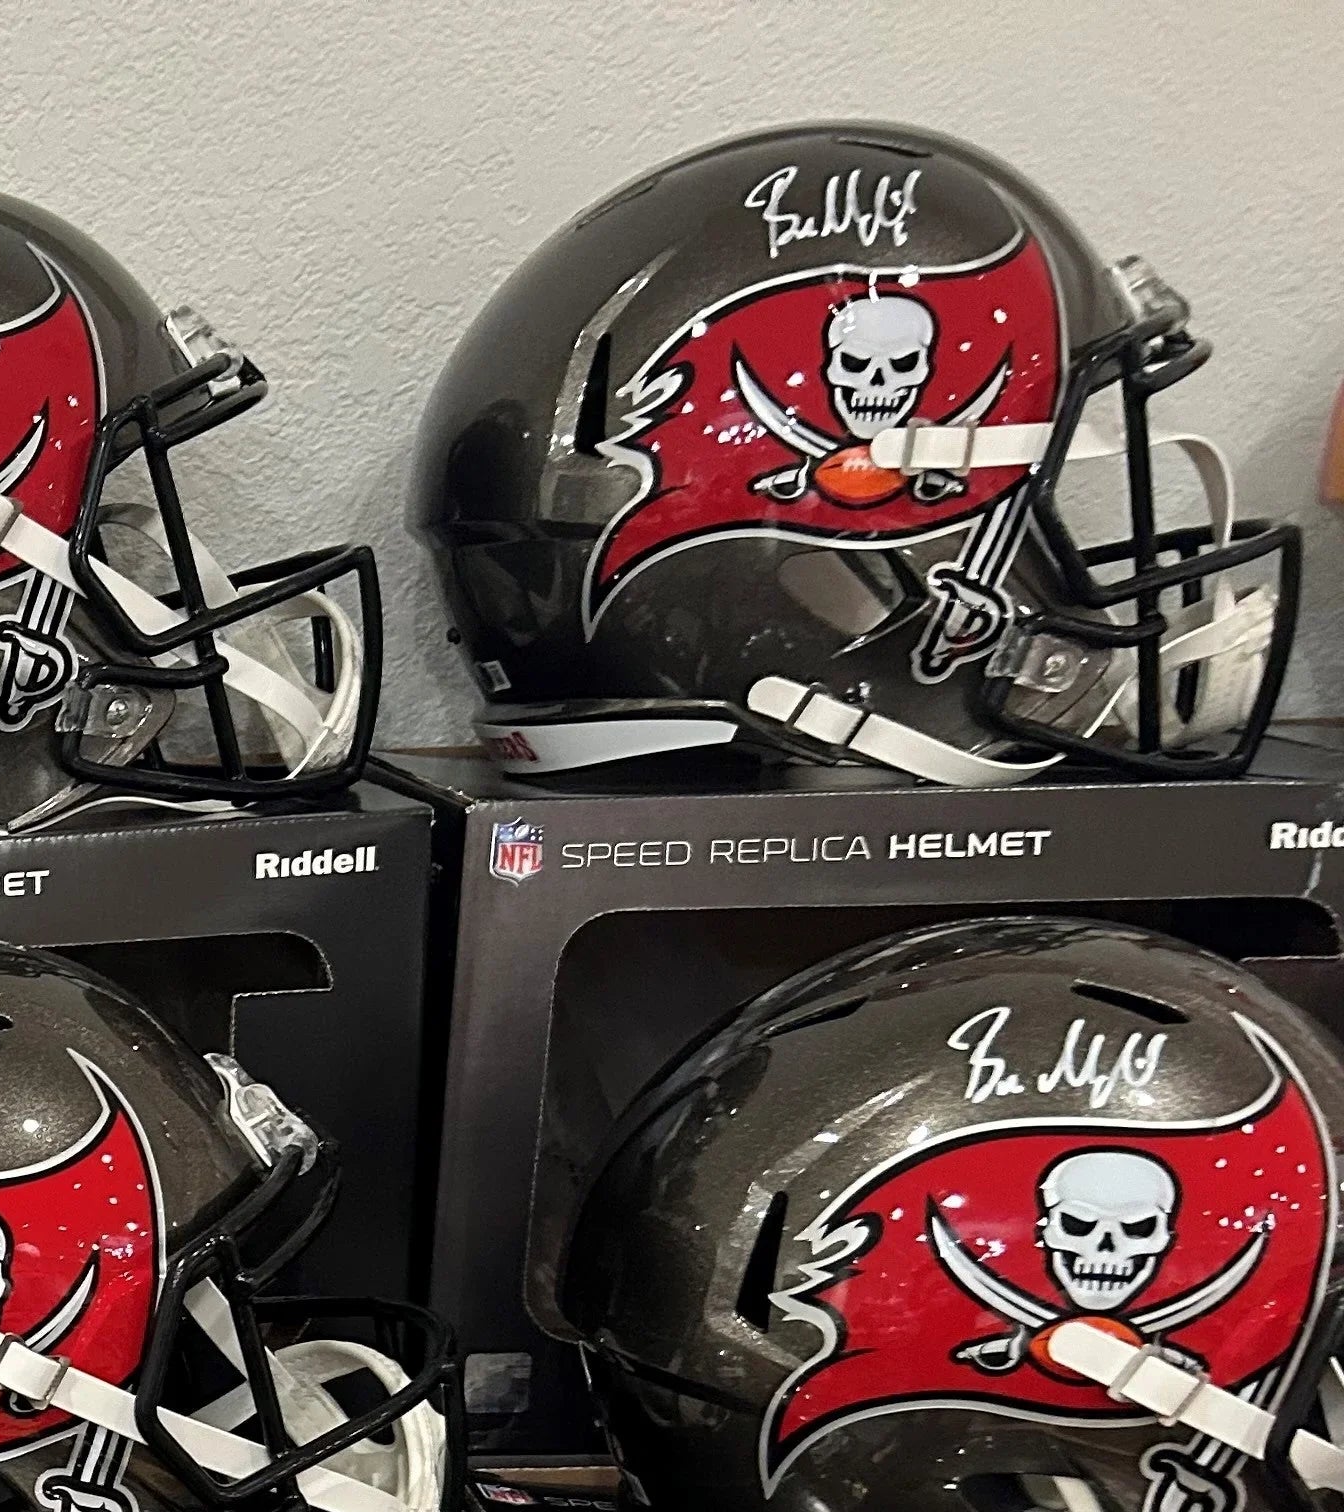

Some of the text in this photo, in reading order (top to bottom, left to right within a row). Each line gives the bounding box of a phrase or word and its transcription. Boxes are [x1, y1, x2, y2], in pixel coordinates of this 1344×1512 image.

[255, 845, 376, 880] Riddell
[498, 844, 540, 873] NFL
[561, 830, 1052, 869] SPEED REPLICA HELMET
